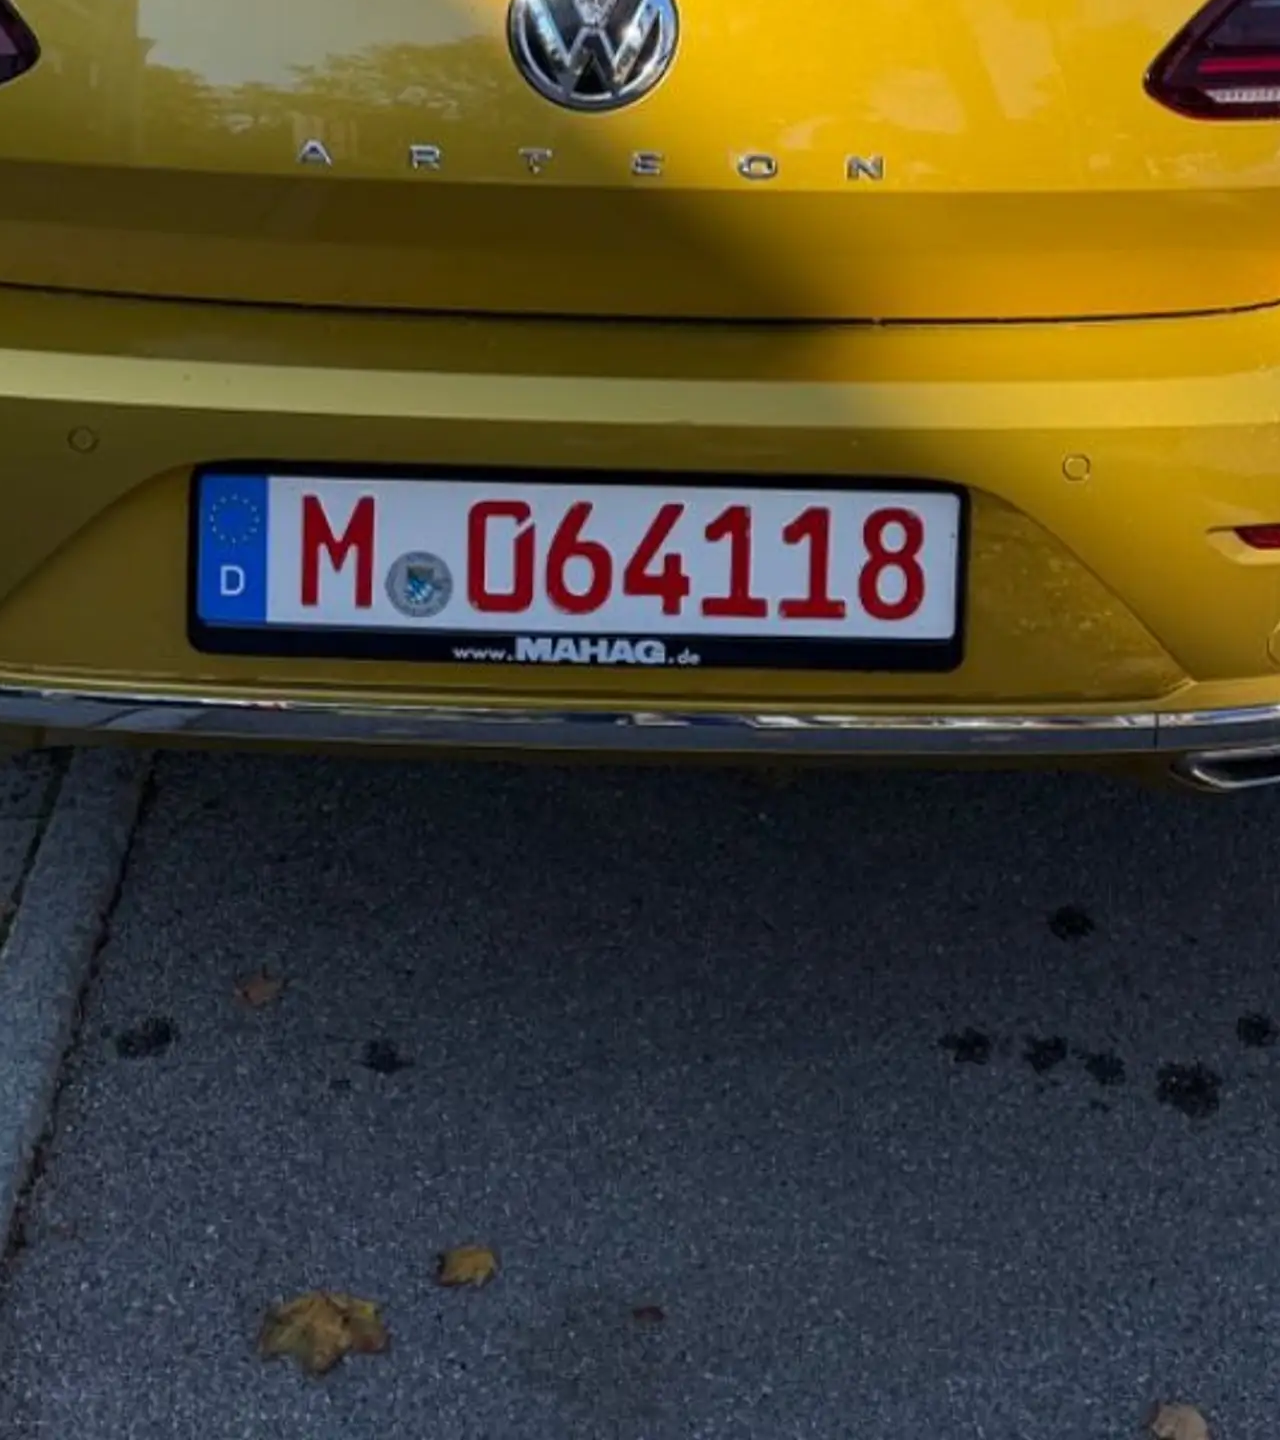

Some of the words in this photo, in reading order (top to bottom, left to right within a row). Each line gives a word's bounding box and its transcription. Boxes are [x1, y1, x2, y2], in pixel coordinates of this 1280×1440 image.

[297, 138, 885, 181] ARTEON
[219, 565, 247, 596] D
[301, 494, 376, 610] M
[466, 499, 927, 623] 064118
[452, 636, 701, 666] www.MAHAG.de
